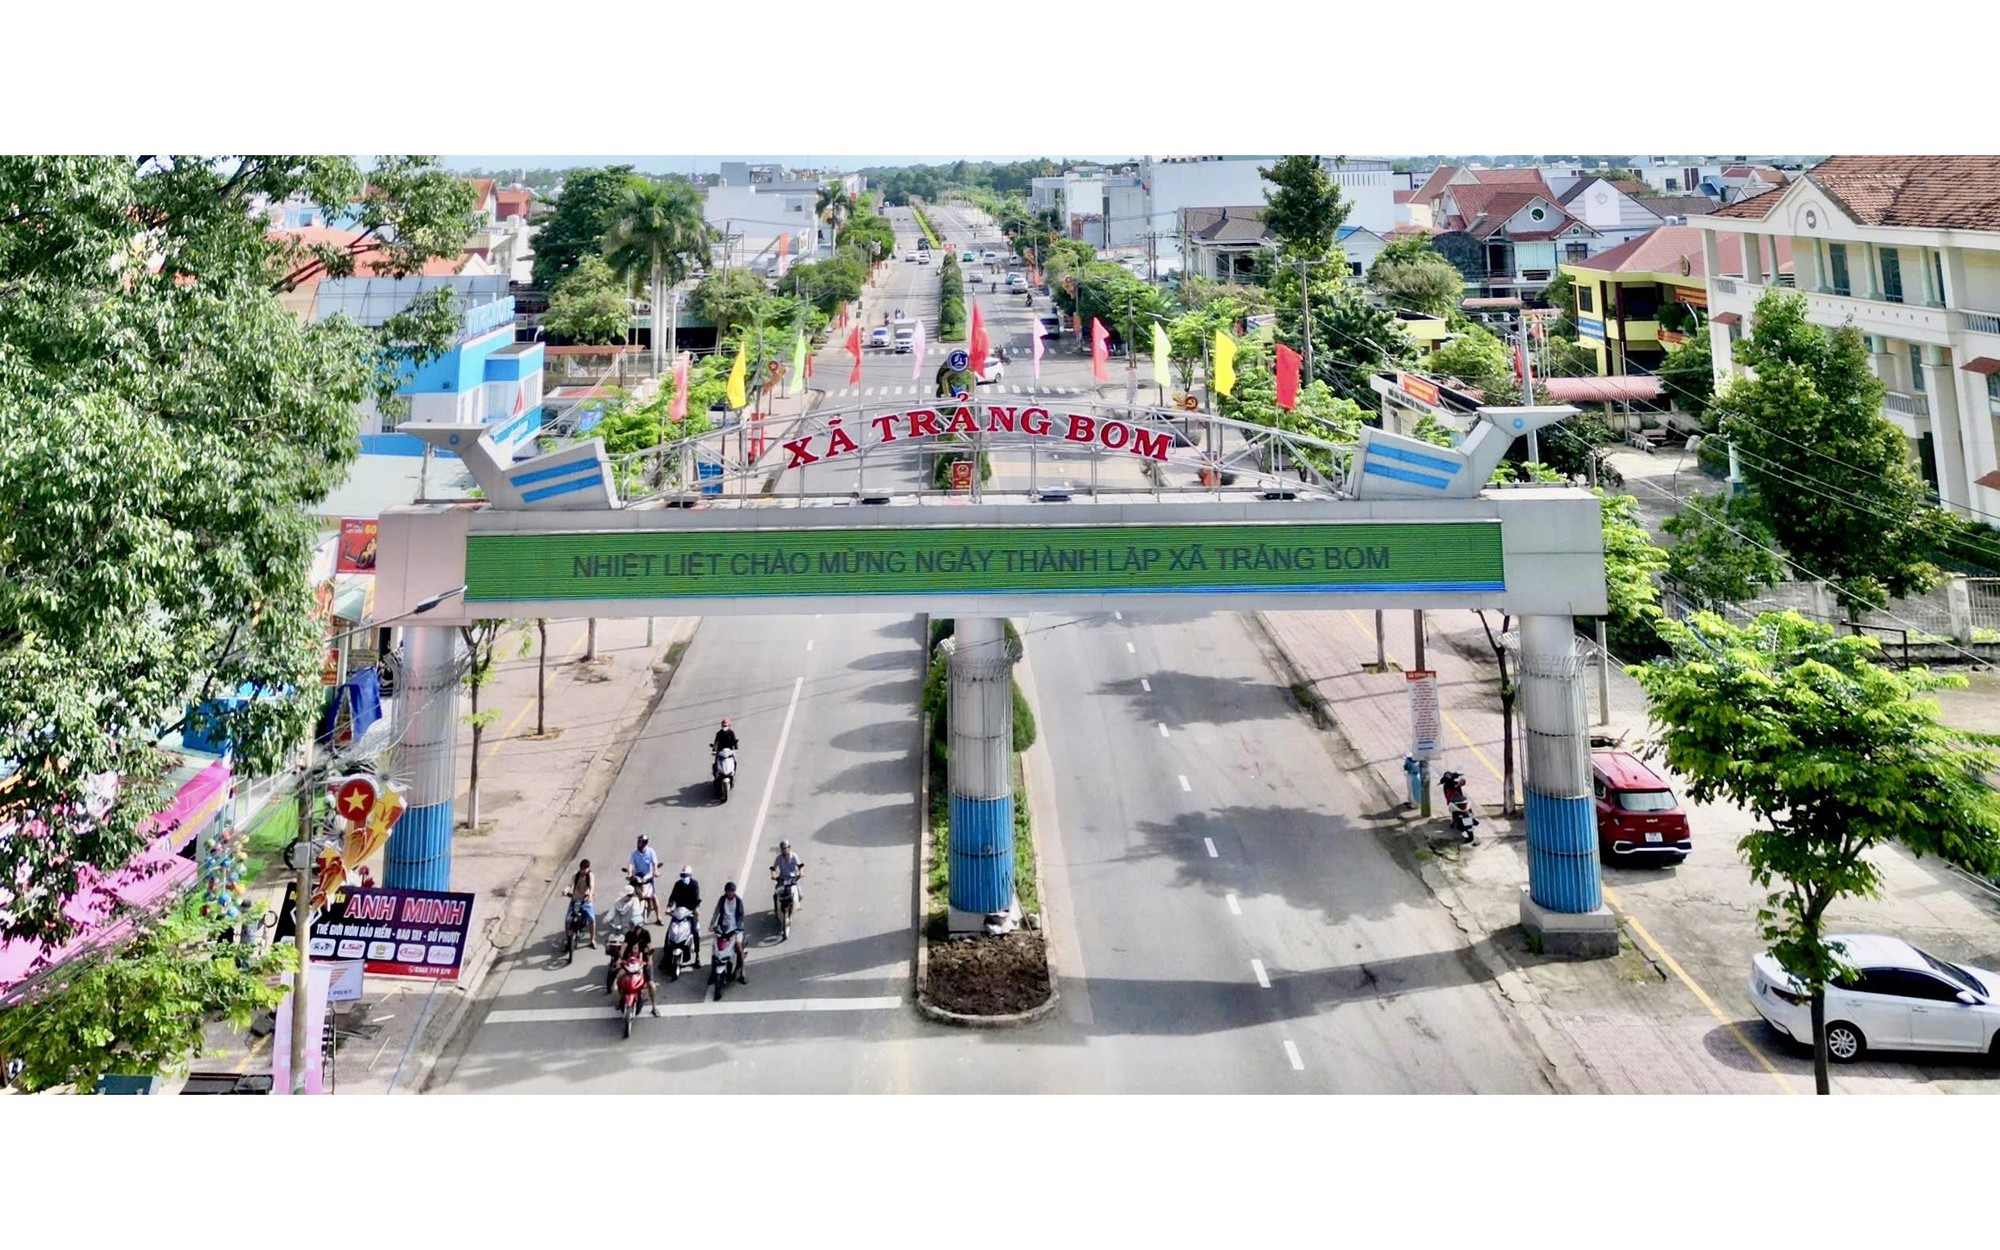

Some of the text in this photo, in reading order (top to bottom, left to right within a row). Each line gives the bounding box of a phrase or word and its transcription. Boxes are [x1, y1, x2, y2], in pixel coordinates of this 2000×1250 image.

[783, 392, 1174, 469] XÃ TRẢNG BOM
[573, 543, 1390, 581] NHIỆT LIỆT CHÀO MỪNG NGÀY THÀNH LẬP XÃ TRẢNG BOM
[344, 894, 395, 920] ANH
[402, 897, 466, 925] MINH
